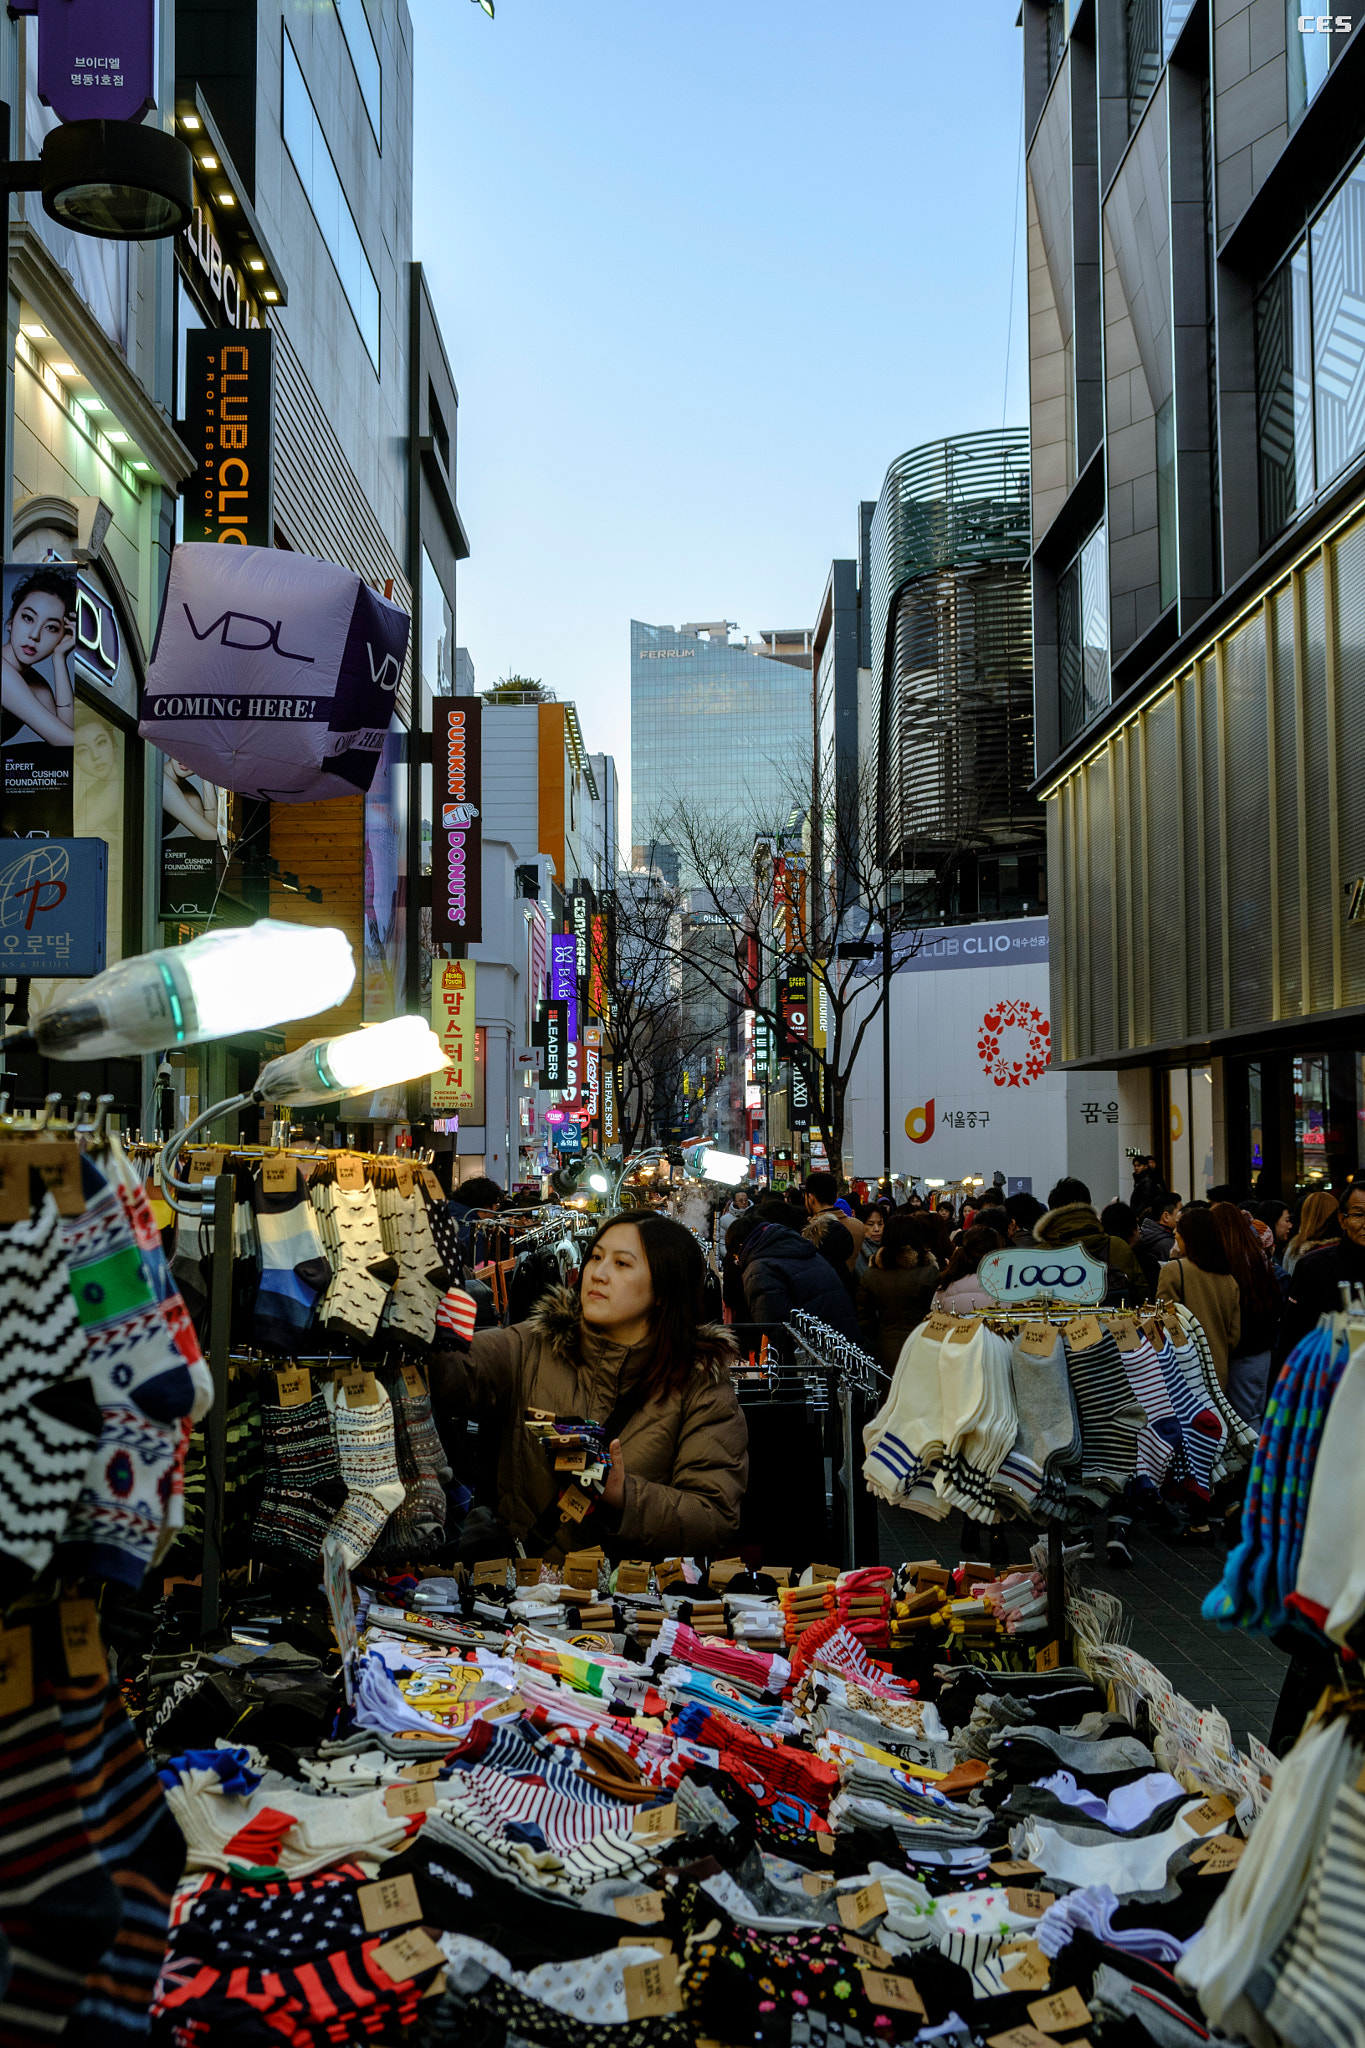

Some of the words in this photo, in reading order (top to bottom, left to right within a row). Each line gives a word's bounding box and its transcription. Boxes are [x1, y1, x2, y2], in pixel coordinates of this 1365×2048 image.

[74, 56, 120, 70] 브이디엘
[71, 73, 124, 87] 명동1호점
[221, 346, 248, 449] CLUB
[204, 356, 214, 535] PROFESSIONA
[183, 602, 315, 663] VDL
[640, 649, 695, 659] FERRUM
[153, 698, 241, 718] COMING
[247, 699, 316, 719] HERE!
[5, 763, 35, 771] EXPERT
[31, 770, 69, 778] CUSHION
[5, 778, 57, 787] FOUNDATION
[448, 832, 466, 921] DONUTS
[170, 904, 208, 914] VDL
[963, 935, 1011, 954] CLIO
[443, 992, 464, 1087] 맘스터치
[548, 1019, 558, 1080] LEADERS
[604, 1070, 613, 1088] THE
[604, 1089, 613, 1112] FACE
[604, 1113, 613, 1138] SHOP
[941, 1110, 991, 1130] 서울중구
[389, 1882, 399, 1907] TWO
[643, 1968, 654, 1998] RAIN
[651, 1964, 662, 1995] TWO
